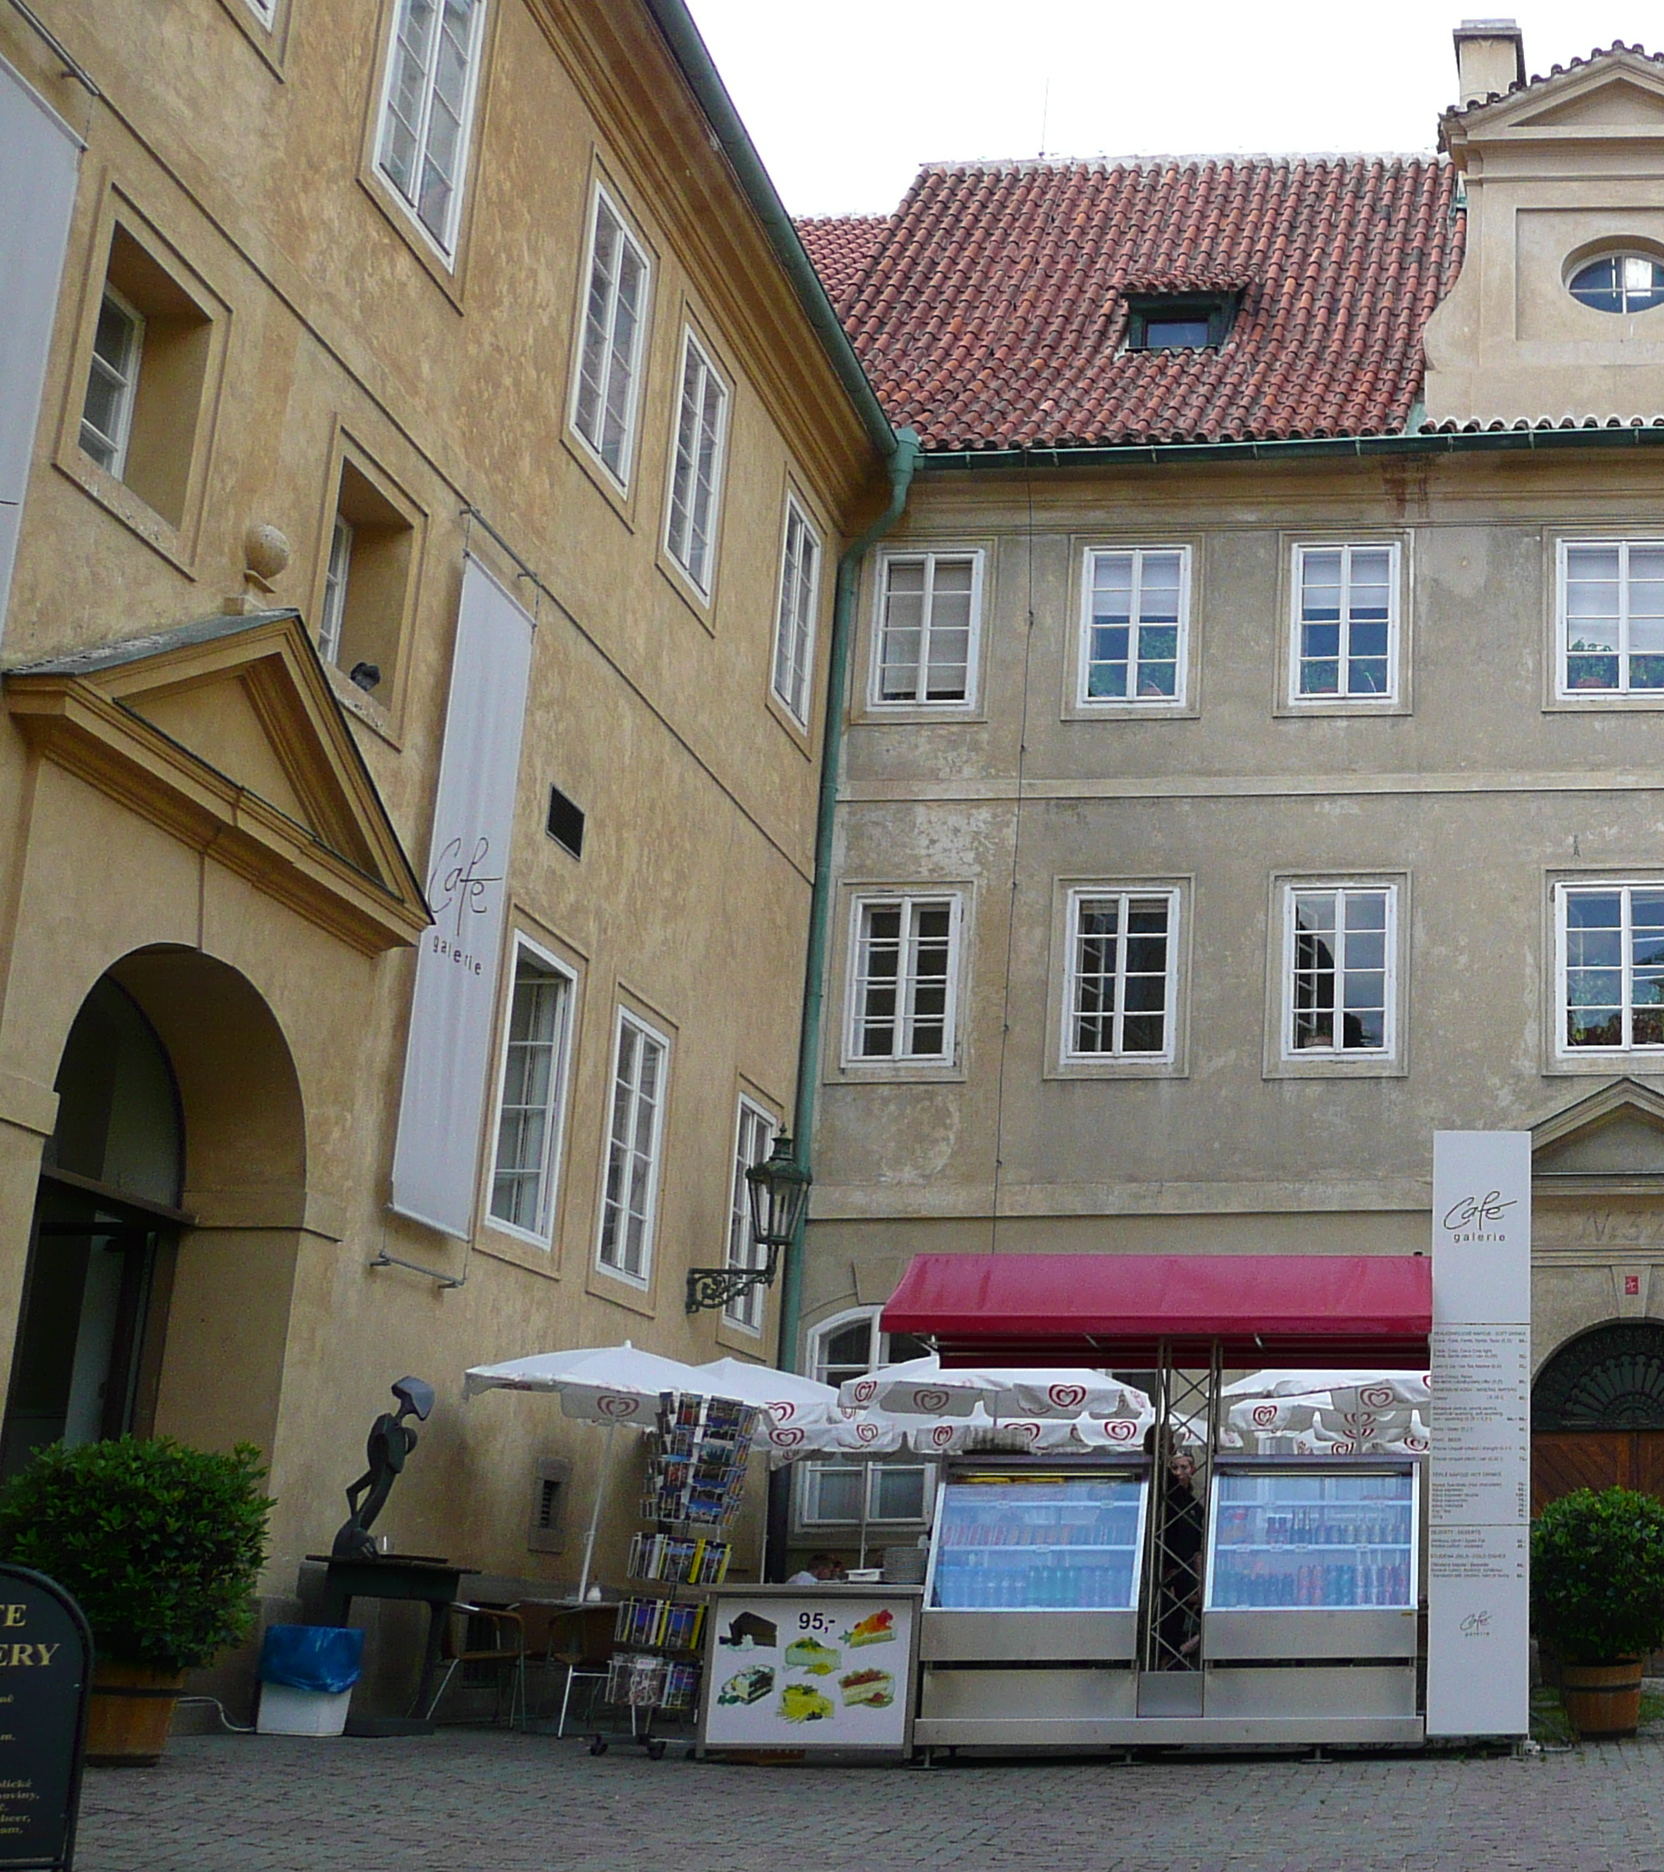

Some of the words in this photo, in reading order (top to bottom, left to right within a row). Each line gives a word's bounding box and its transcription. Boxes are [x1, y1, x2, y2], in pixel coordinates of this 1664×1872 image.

[433, 935, 482, 975] galerie
[1453, 1232, 1505, 1243] galerie
[799, 1612, 836, 1634] 95,-
